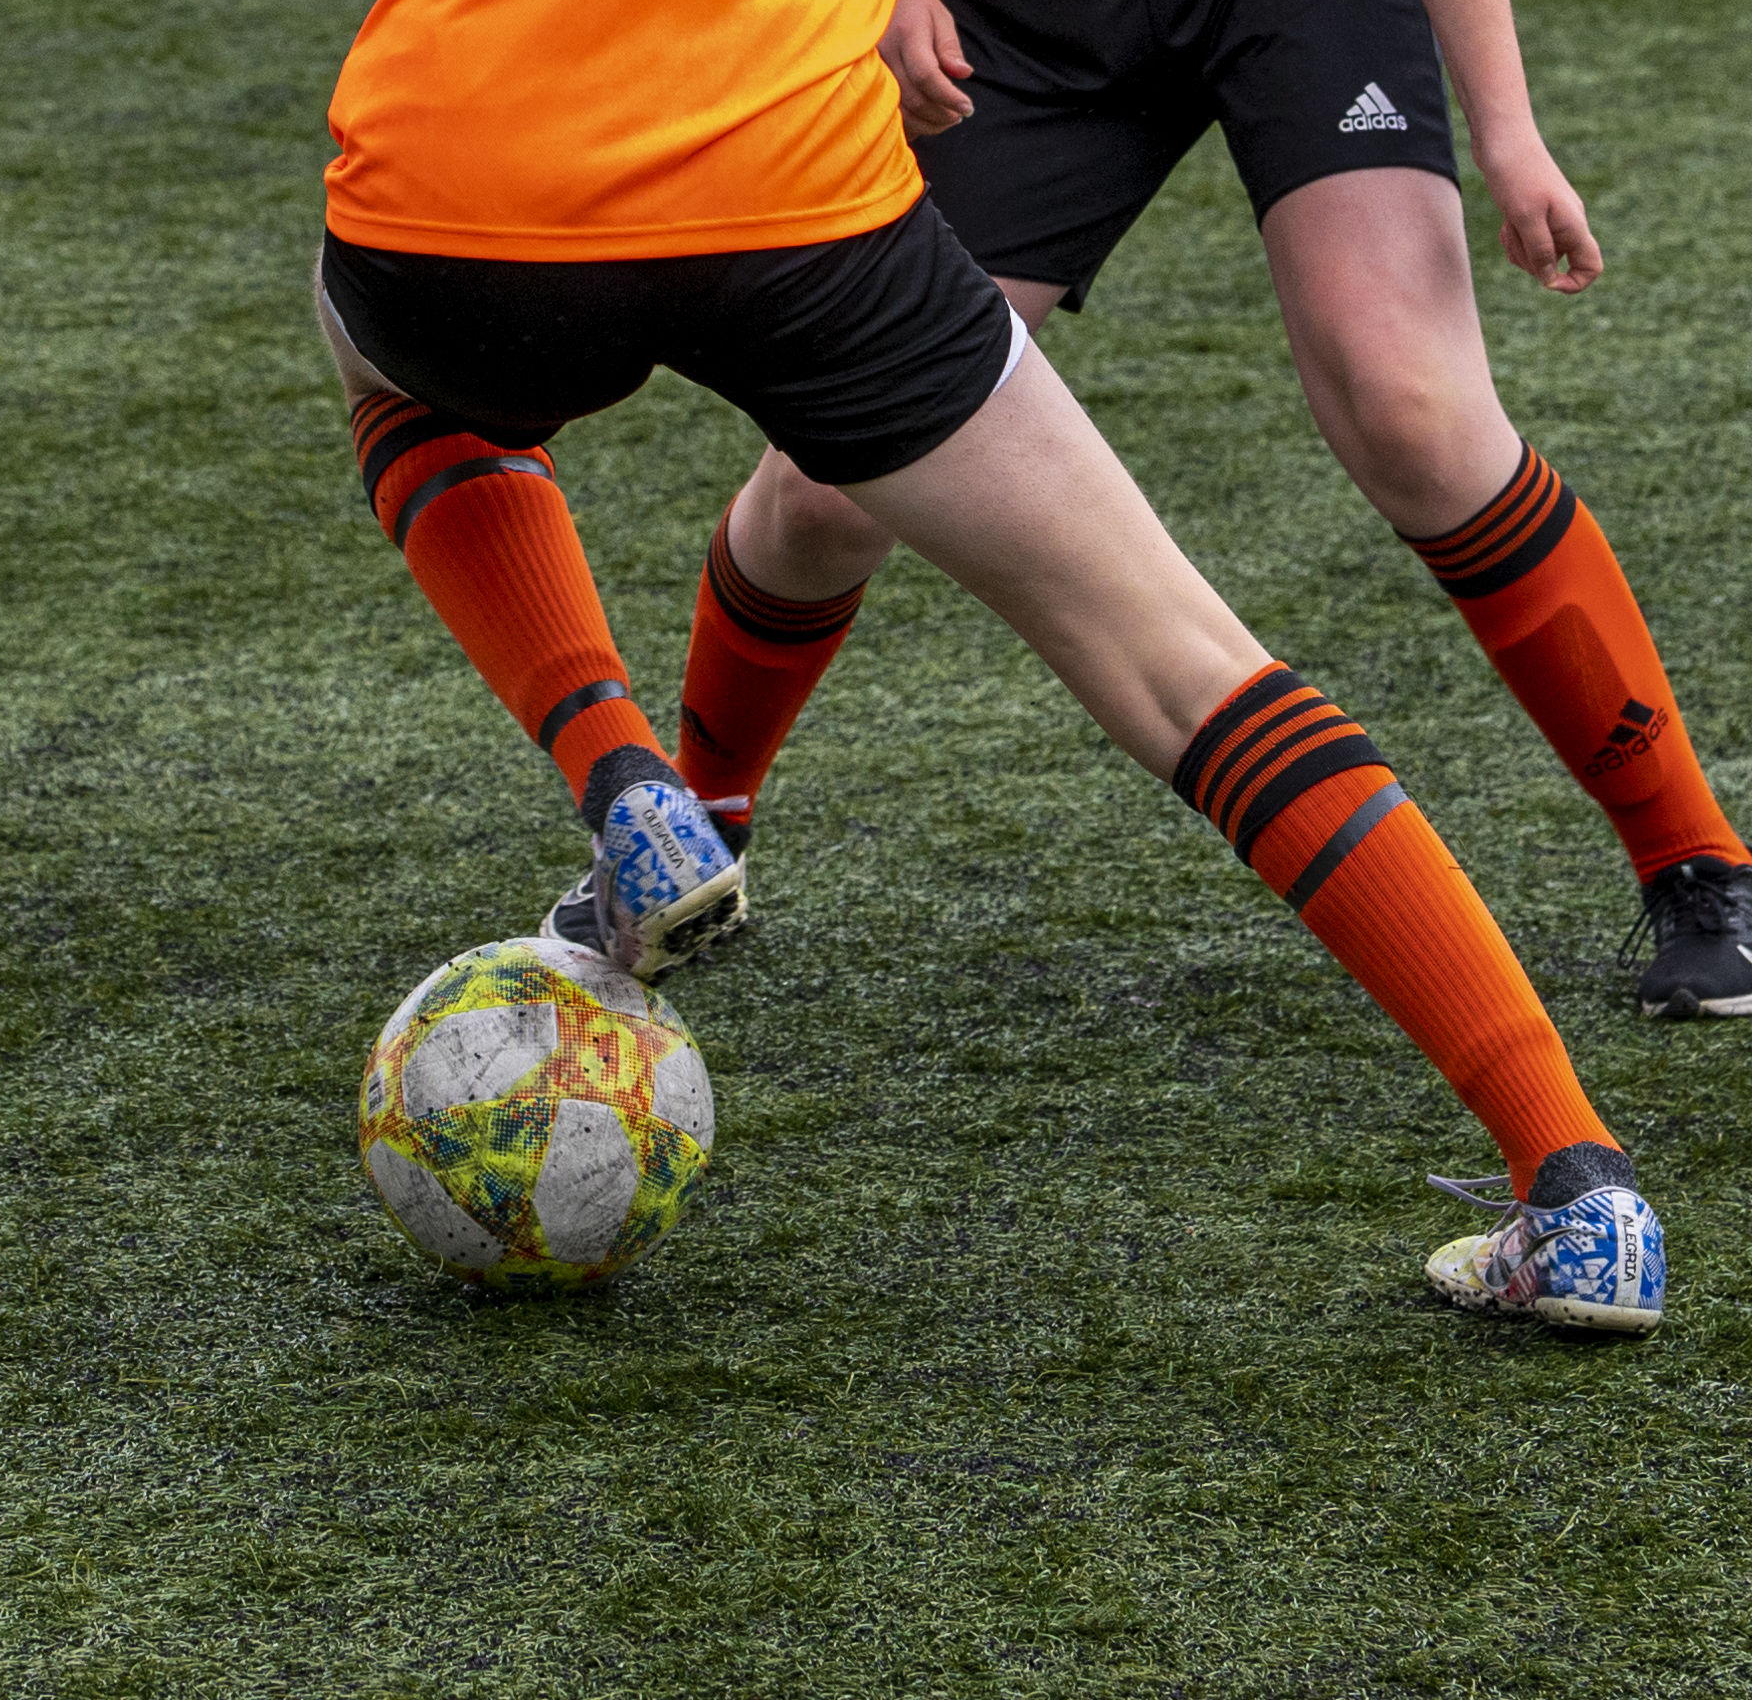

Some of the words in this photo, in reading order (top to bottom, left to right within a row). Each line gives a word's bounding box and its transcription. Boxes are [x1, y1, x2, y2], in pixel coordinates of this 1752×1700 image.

[1338, 113, 1408, 132] adidas
[1584, 707, 1669, 777] adidas
[1621, 1214, 1638, 1283] ALEGRIA
